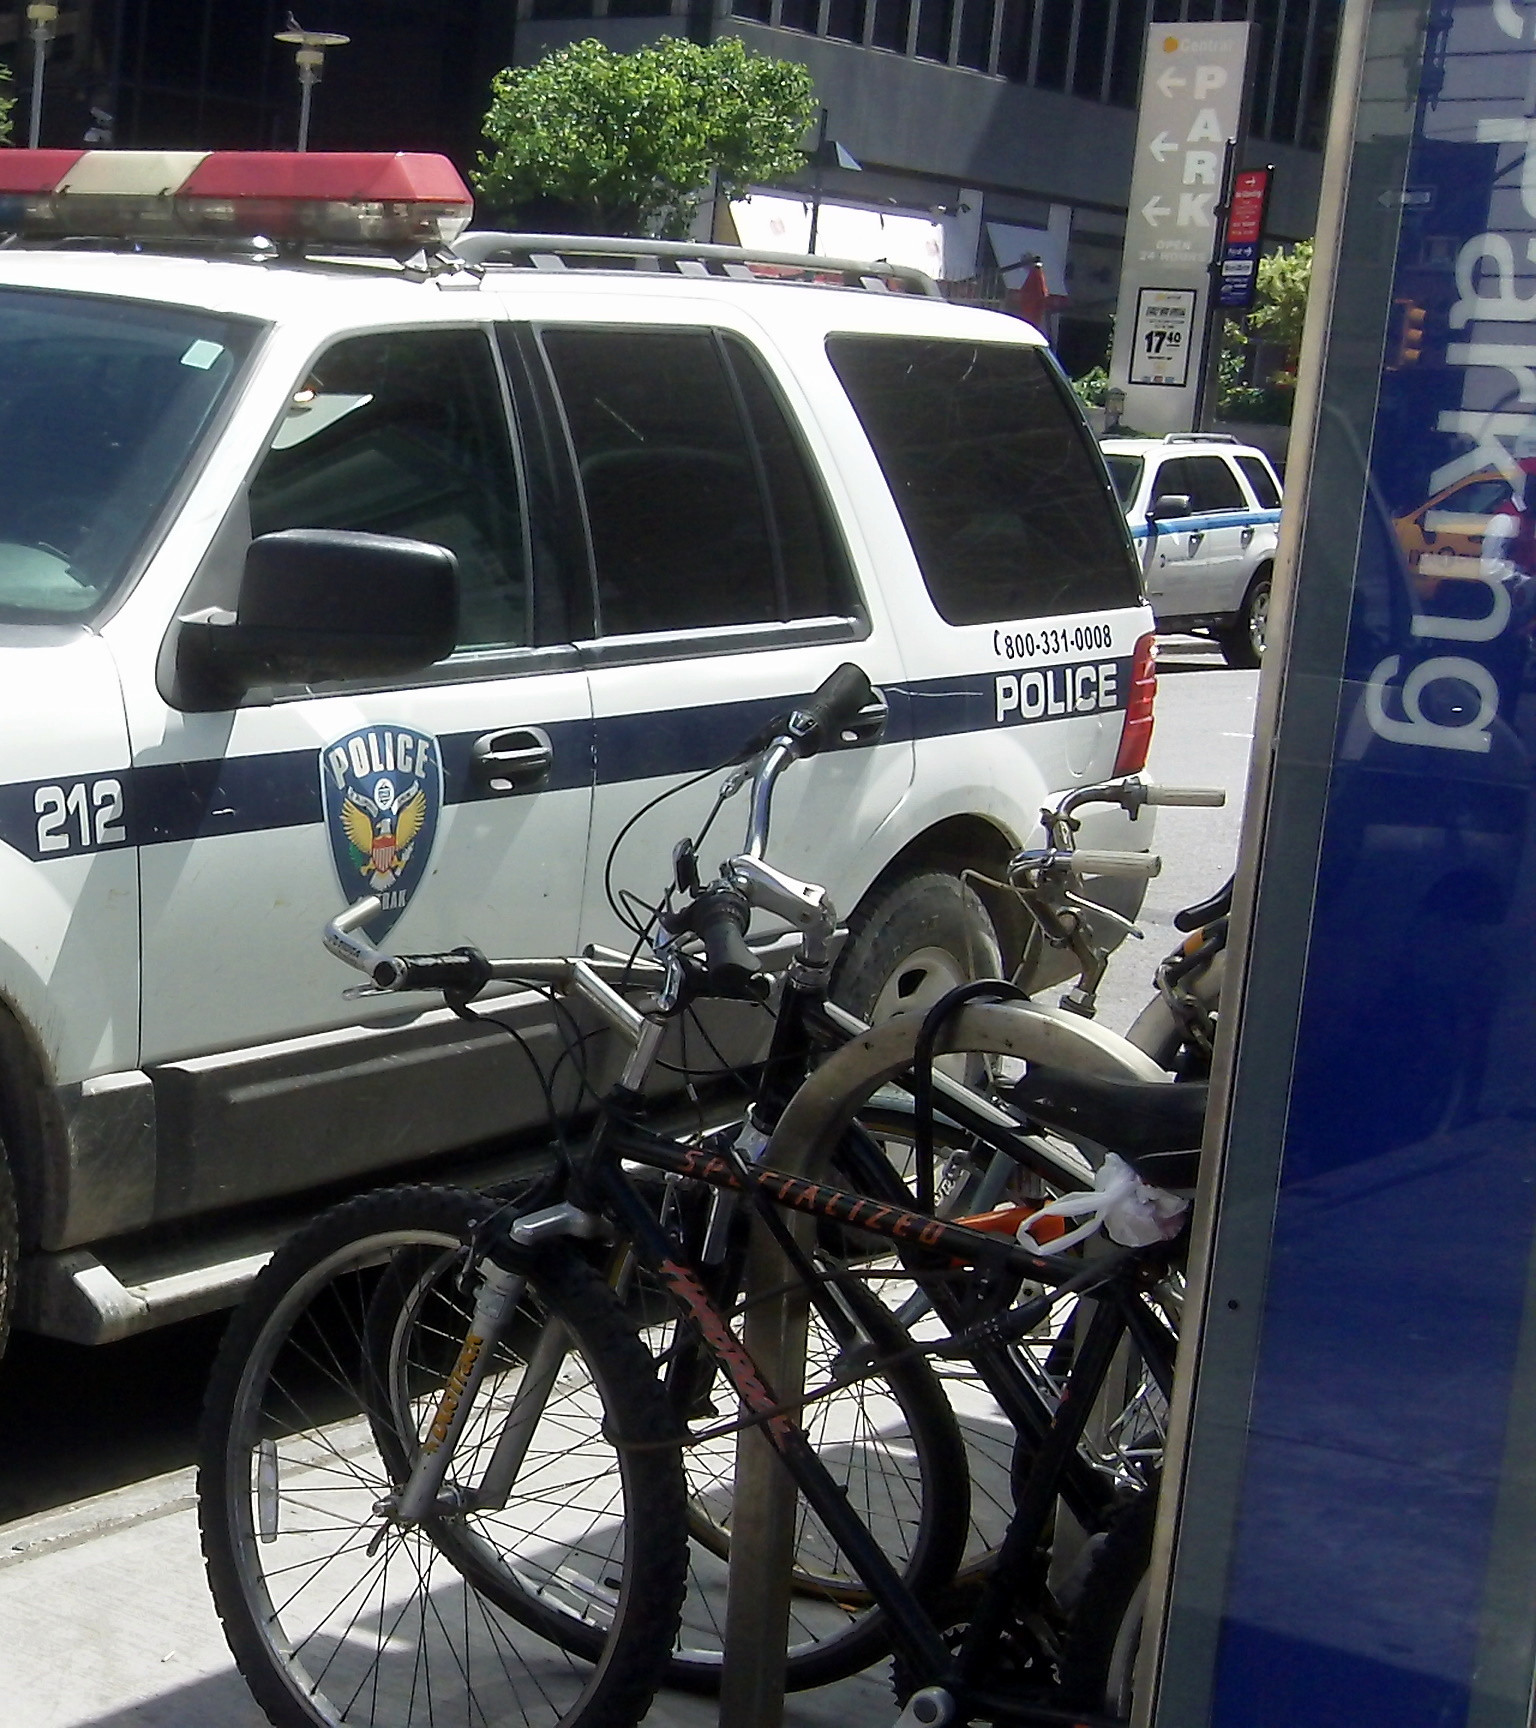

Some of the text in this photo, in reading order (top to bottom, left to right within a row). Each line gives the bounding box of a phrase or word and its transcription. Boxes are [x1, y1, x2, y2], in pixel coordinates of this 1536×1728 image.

[996, 664, 1118, 722] POLICE
[328, 732, 430, 790] POLICE
[34, 779, 126, 852] 212
